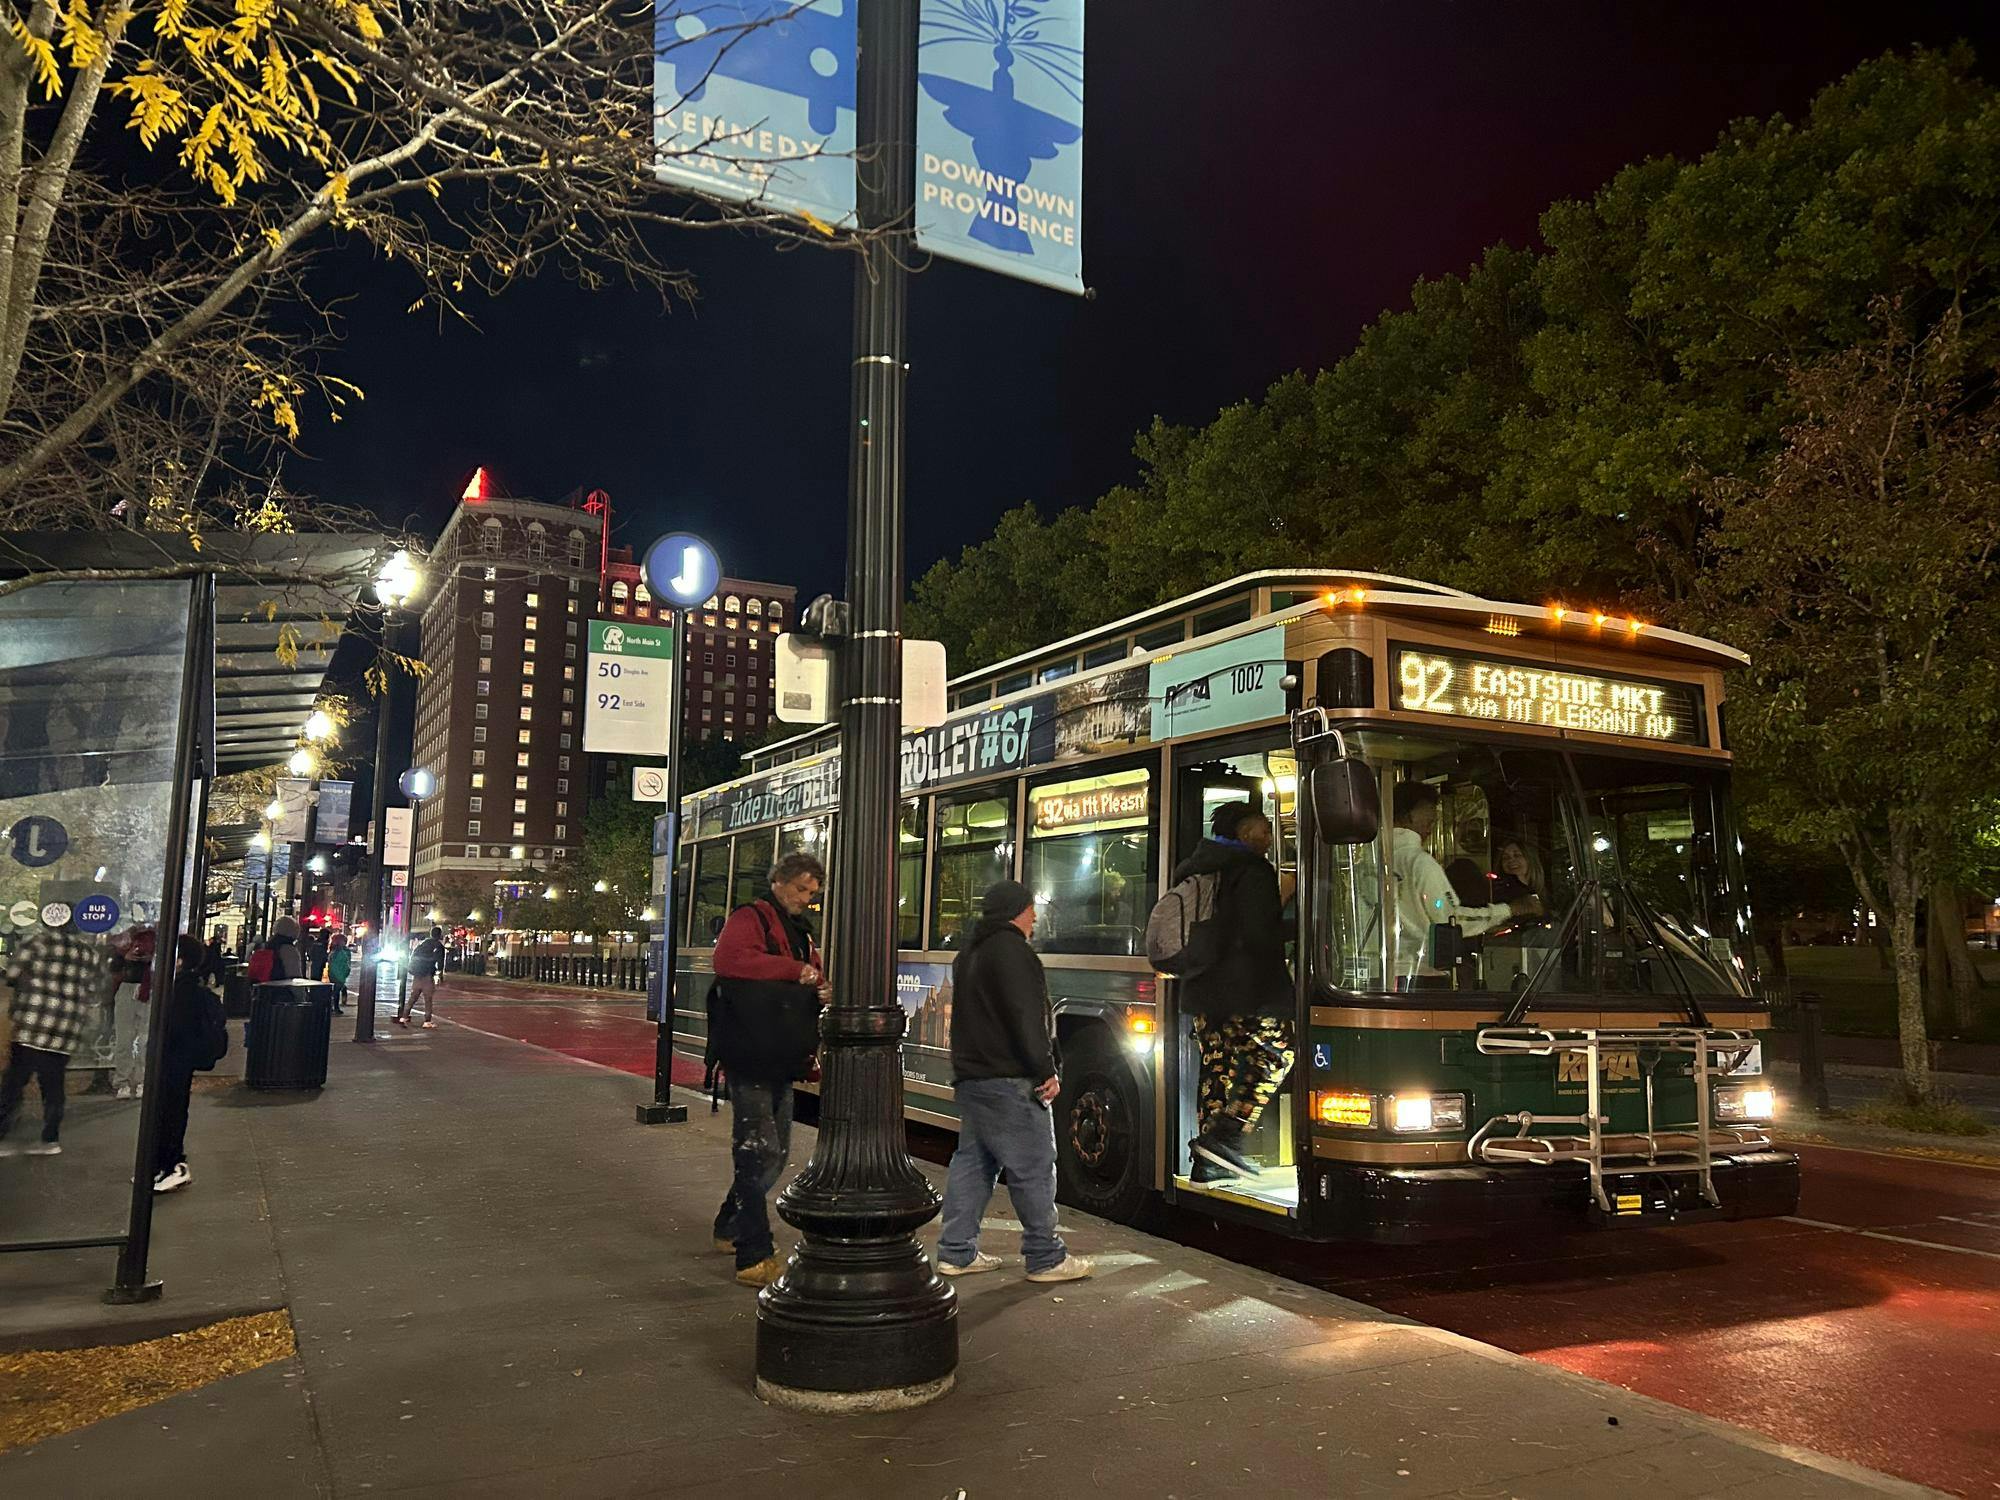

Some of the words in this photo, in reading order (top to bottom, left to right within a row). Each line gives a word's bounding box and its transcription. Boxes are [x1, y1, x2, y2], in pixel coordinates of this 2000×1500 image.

[656, 104, 822, 162] KENNEDY
[924, 153, 1075, 218] DOWNTOWN
[923, 182, 1075, 247] PROVIDENCE
[670, 547, 700, 595] J
[626, 636, 641, 645] North
[642, 638, 655, 646] Main
[598, 662, 621, 678] 50
[1231, 664, 1263, 695] 1002
[1400, 655, 1454, 713] 92
[1473, 665, 1604, 708] EASTSIDE
[1610, 685, 1665, 714] MKT
[598, 693, 620, 710] 92
[623, 699, 633, 707] East
[1507, 696, 1534, 723] MT
[1543, 702, 1637, 734] PLEASANT
[1645, 714, 1675, 739] AV
[729, 788, 761, 828] ride
[802, 762, 841, 810] BELL
[899, 721, 979, 787] ROLLEY
[980, 705, 1033, 769] #67
[1044, 799, 1065, 824] 92
[1064, 798, 1080, 819] via
[1082, 794, 1099, 816] Mt
[82, 913, 105, 921] STOP
[88, 904, 106, 912] BUS
